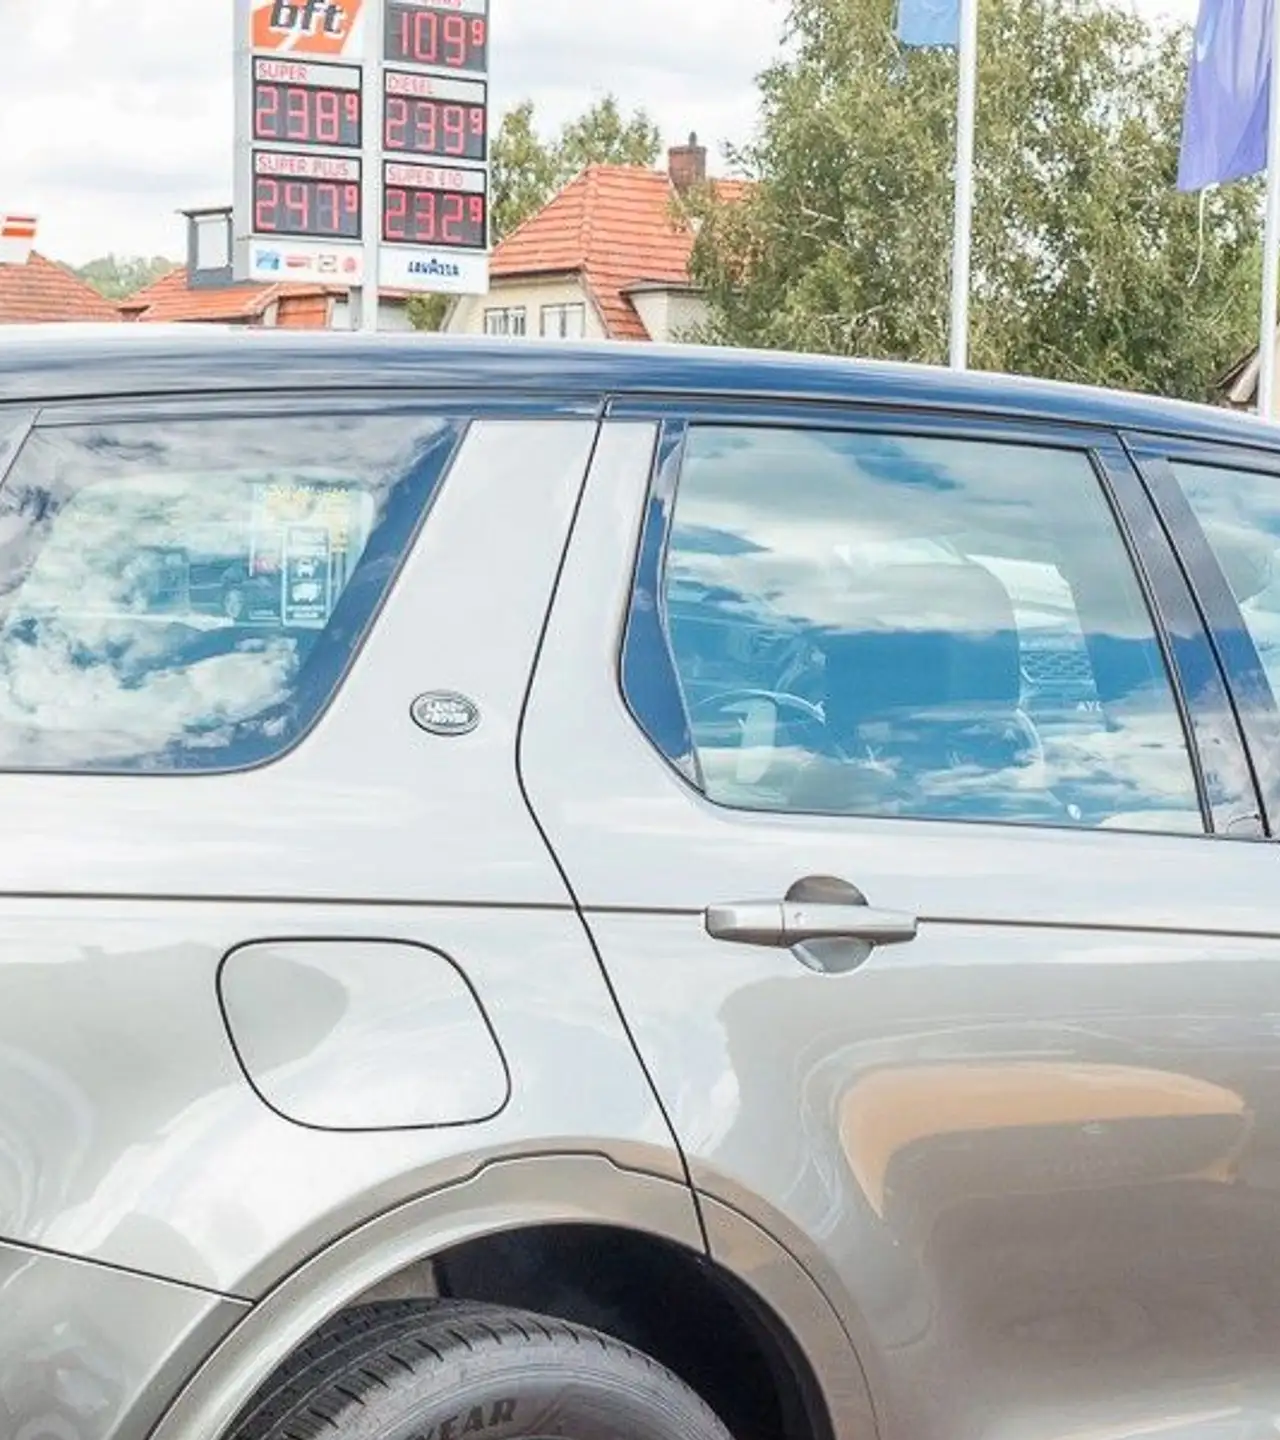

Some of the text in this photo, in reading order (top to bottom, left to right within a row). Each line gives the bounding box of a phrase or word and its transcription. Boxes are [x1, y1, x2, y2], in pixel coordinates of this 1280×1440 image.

[270, 0, 344, 33] bft
[259, 62, 308, 80] SUPER
[259, 155, 349, 177] SUPER PLUS
[388, 165, 435, 185] SUPER
